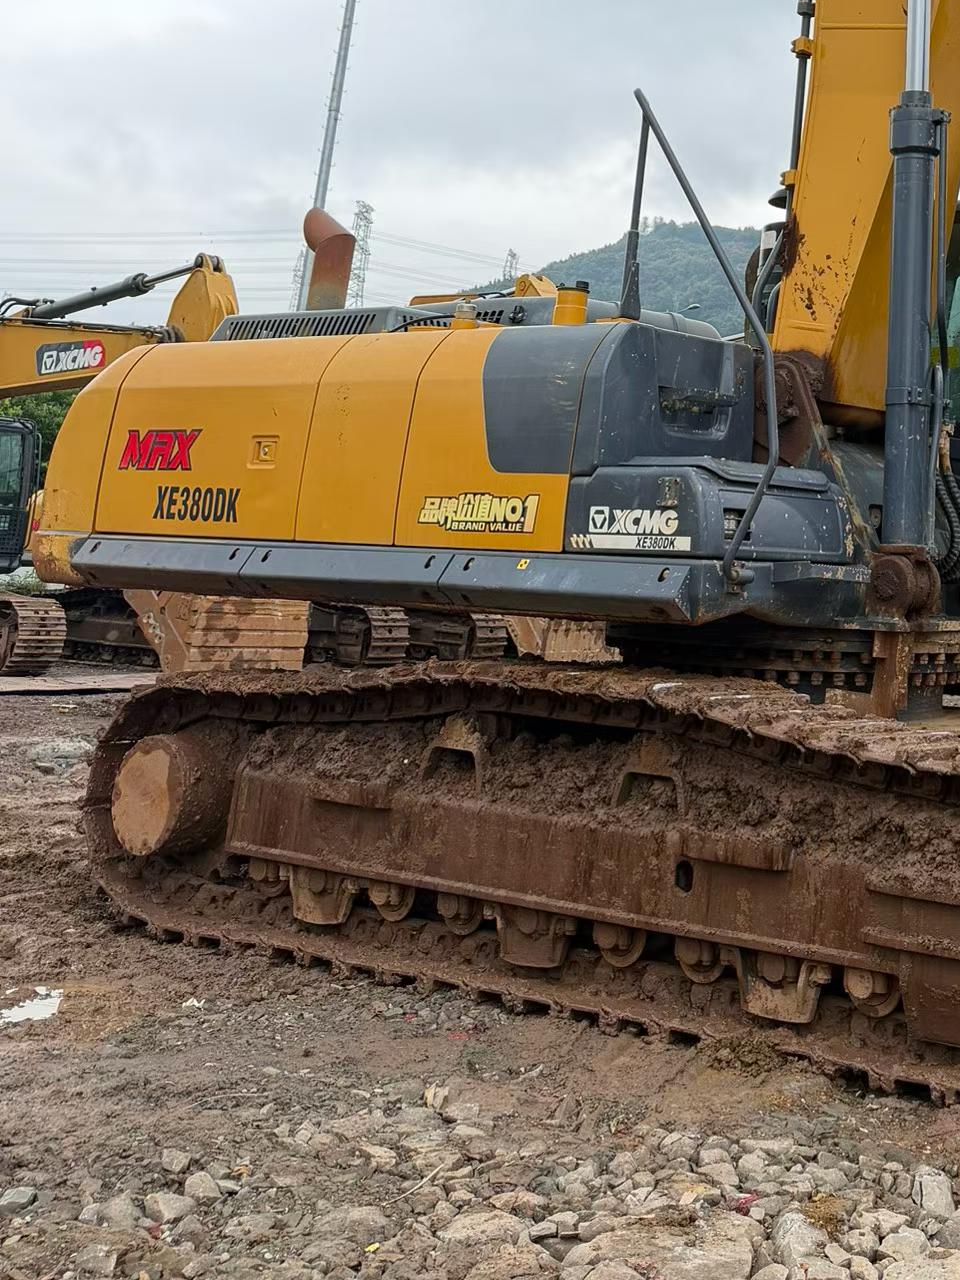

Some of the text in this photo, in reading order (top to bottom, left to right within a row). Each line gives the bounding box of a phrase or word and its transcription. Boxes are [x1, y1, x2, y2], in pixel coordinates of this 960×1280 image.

[56, 345, 103, 371] XCMG
[118, 428, 203, 471] MAX
[152, 485, 241, 523] XE380DK
[451, 521, 523, 533] BRAND VALUE
[607, 509, 679, 536] XCMG
[635, 536, 677, 550] XE380DK
